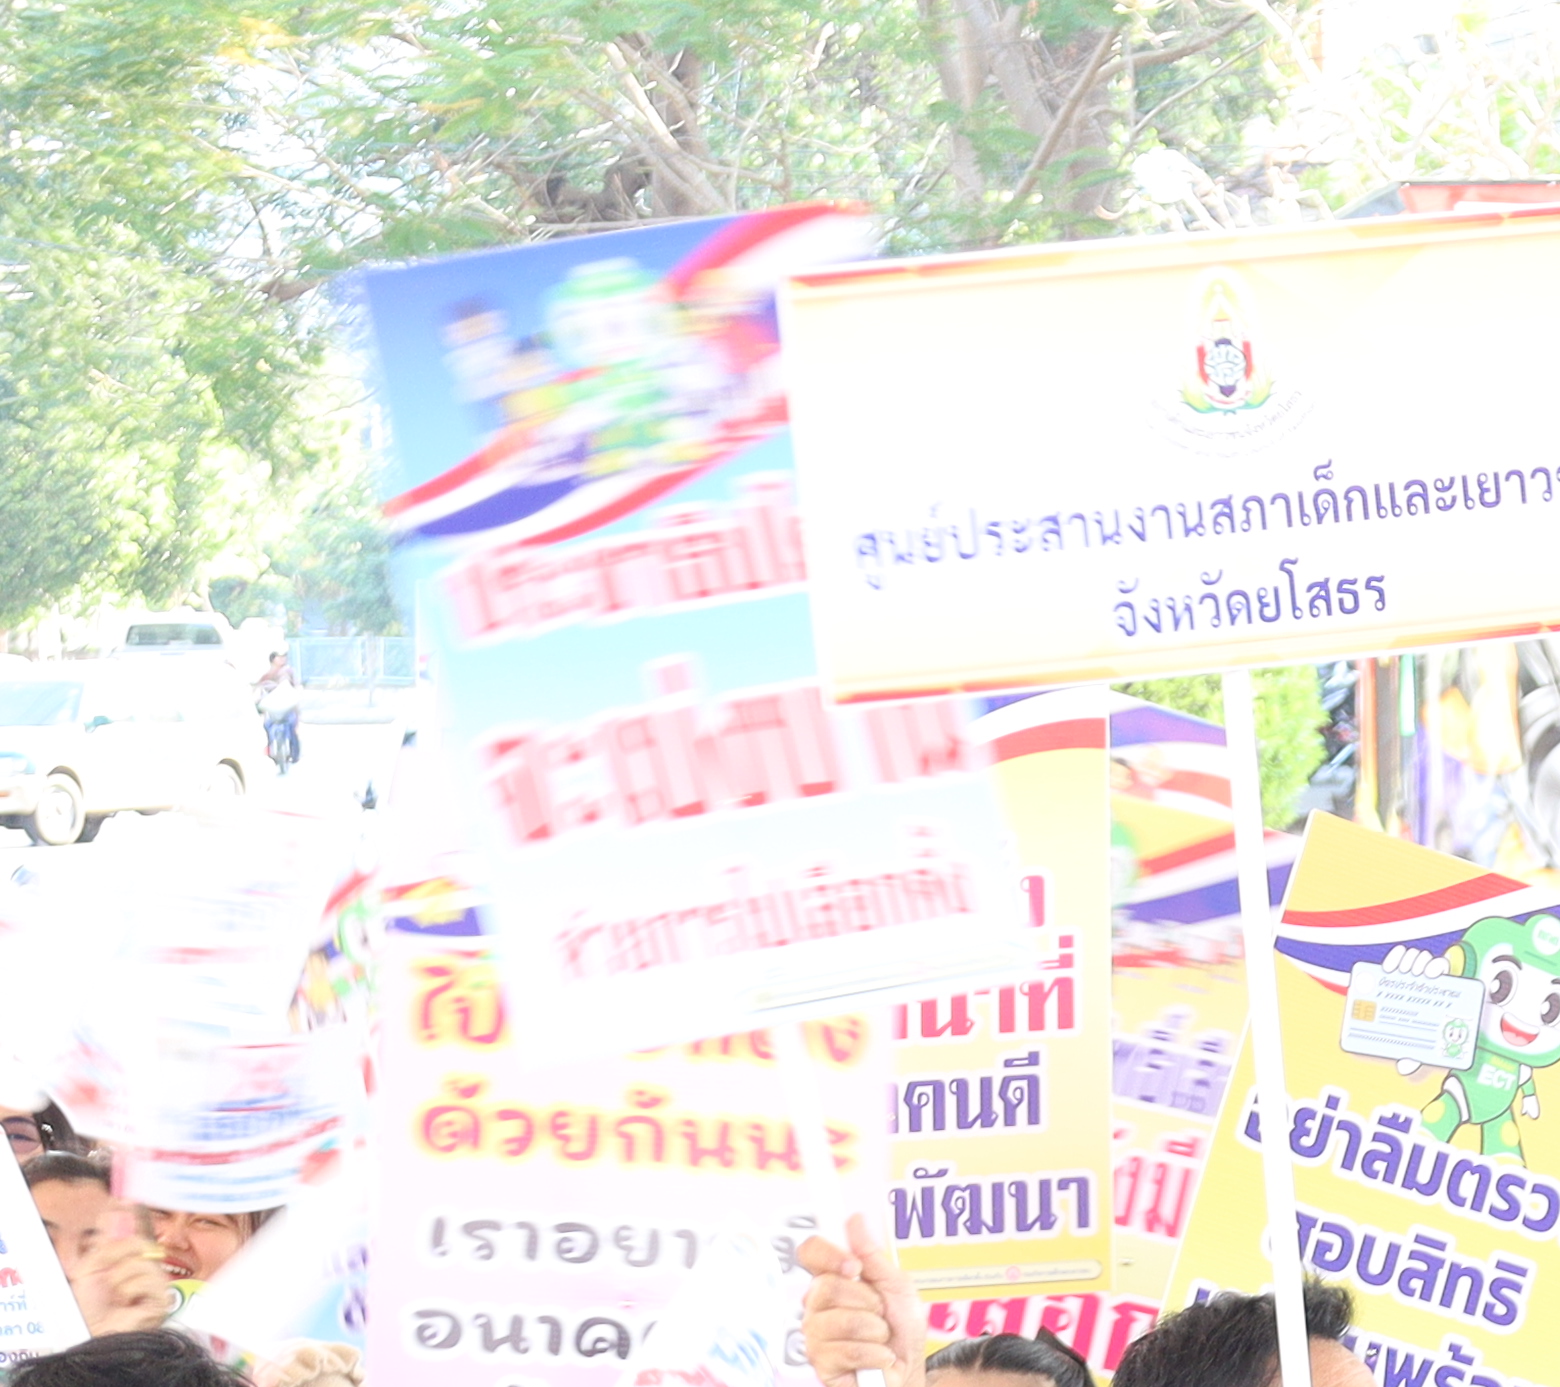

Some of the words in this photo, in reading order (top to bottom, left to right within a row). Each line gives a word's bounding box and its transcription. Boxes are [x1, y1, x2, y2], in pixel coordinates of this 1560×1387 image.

[1112, 556, 1390, 640] จังหวัดยโสธร
[1477, 1064, 1517, 1091] ECT
